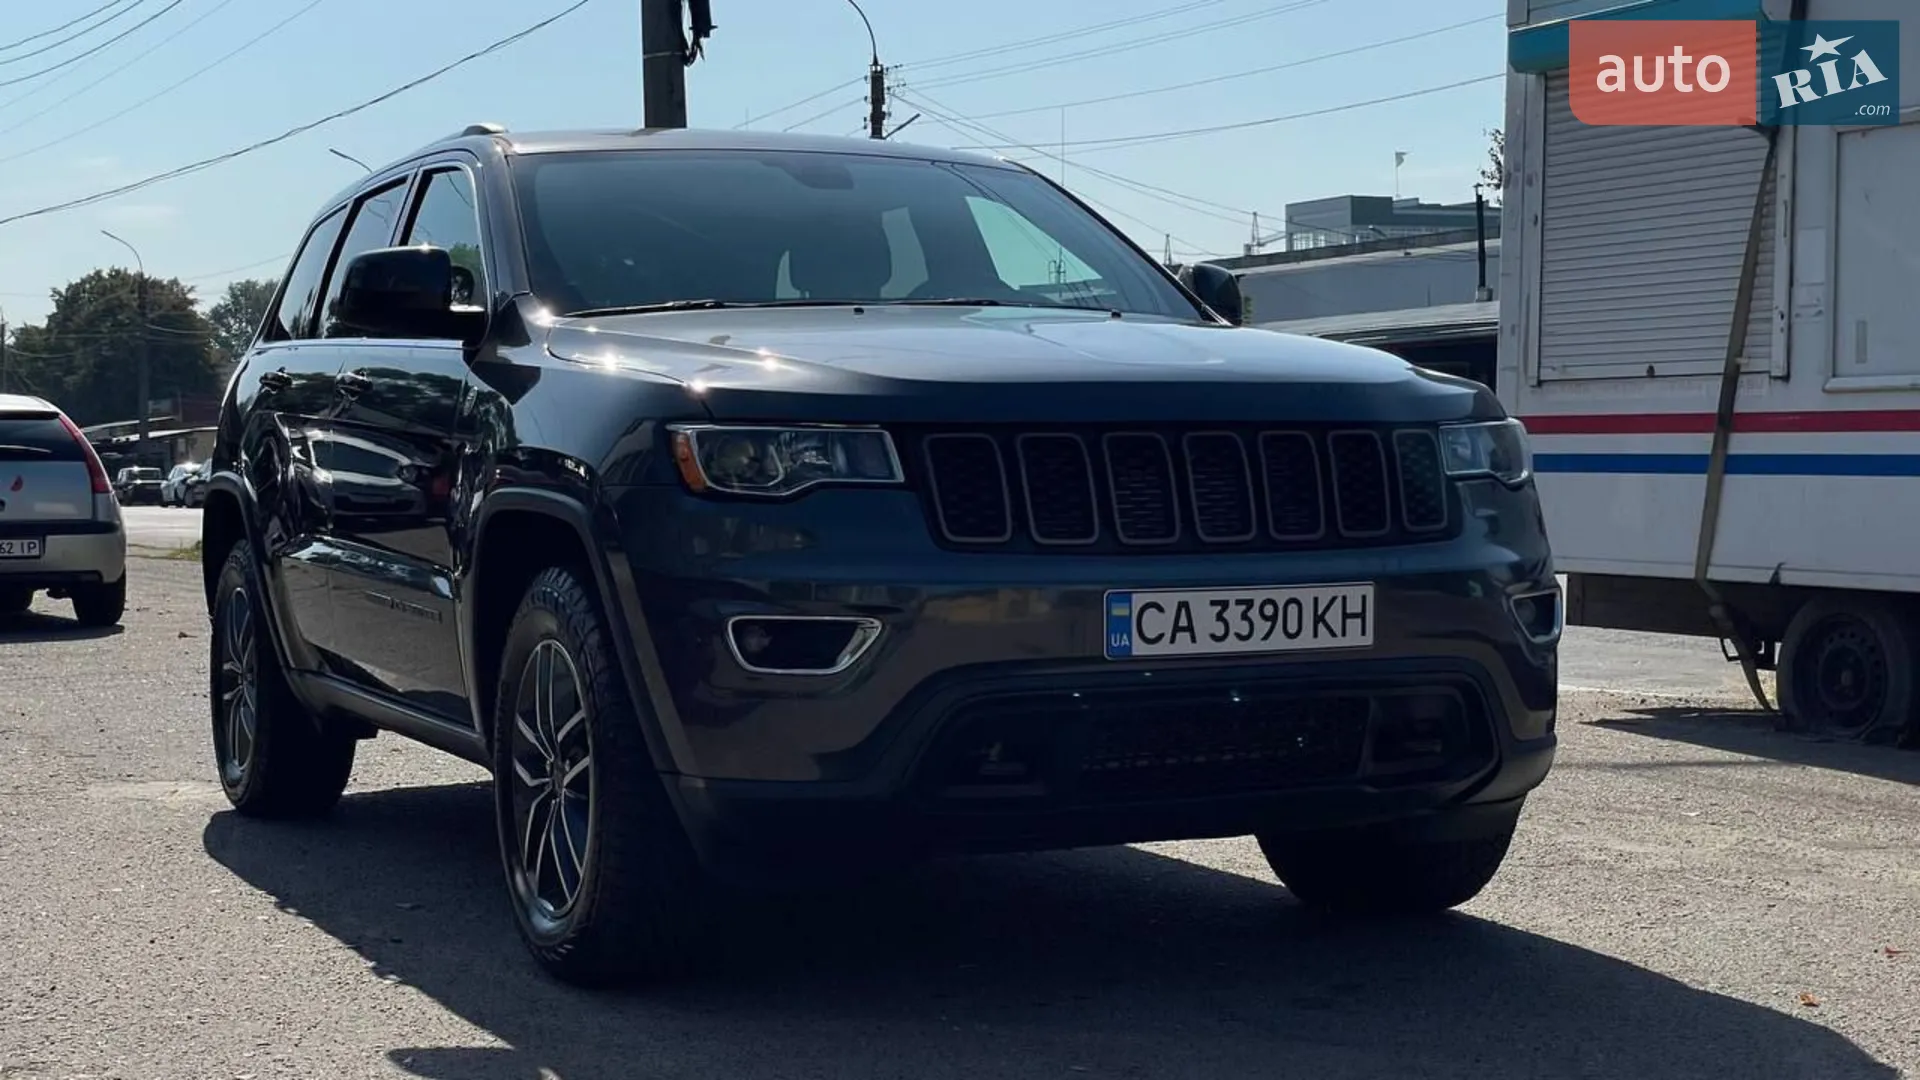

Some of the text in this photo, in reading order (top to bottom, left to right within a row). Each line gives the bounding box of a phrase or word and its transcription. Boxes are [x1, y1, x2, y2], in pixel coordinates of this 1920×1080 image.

[21, 541, 37, 554] IP
[1136, 594, 1367, 645] CA 3390 KH
[1111, 633, 1130, 648] UA
